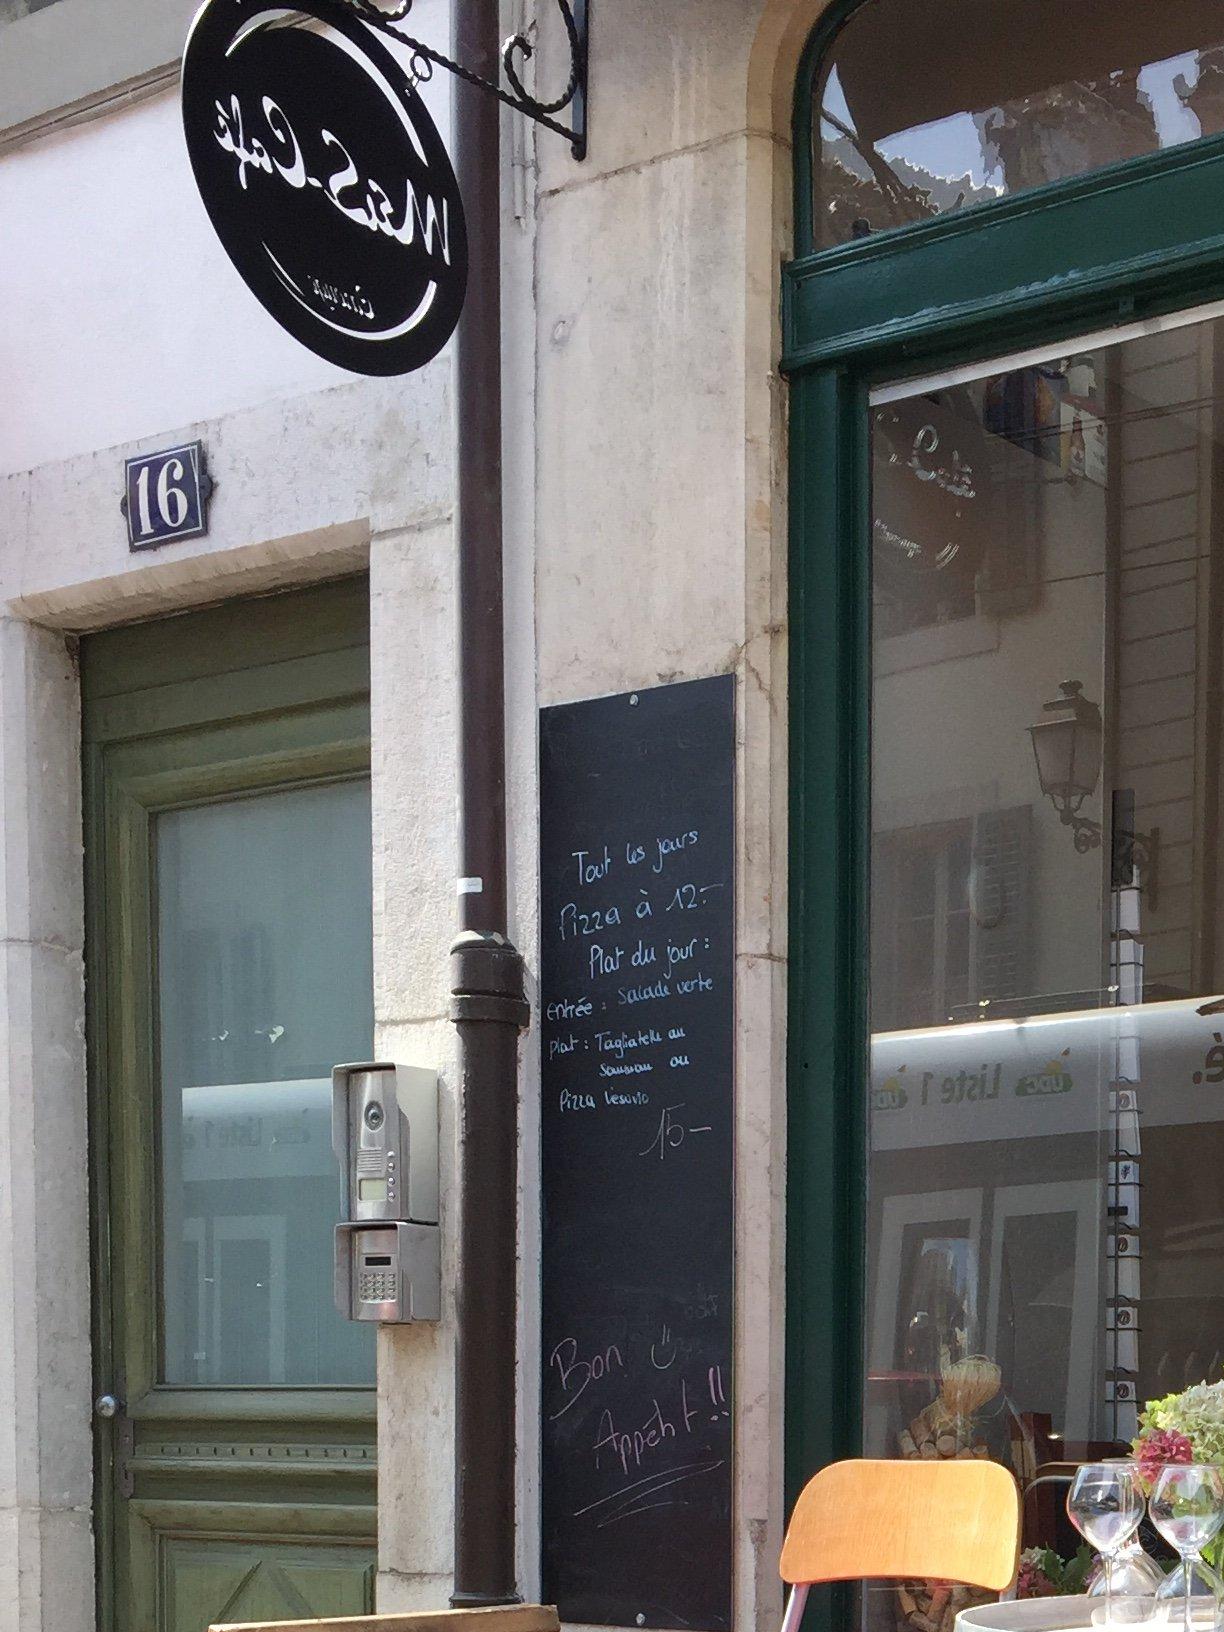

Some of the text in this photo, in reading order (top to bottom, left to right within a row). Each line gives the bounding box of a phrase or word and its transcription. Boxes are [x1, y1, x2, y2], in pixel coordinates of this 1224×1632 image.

[136, 458, 188, 535] 16
[571, 845, 611, 885] Tout
[652, 830, 698, 874] jours
[559, 902, 621, 941] Pizza
[635, 888, 653, 919] à
[589, 943, 624, 979] Plat
[631, 939, 656, 967] du
[676, 972, 713, 994] verte
[560, 1088, 596, 1112] Pizza
[549, 1337, 624, 1421] Bon
